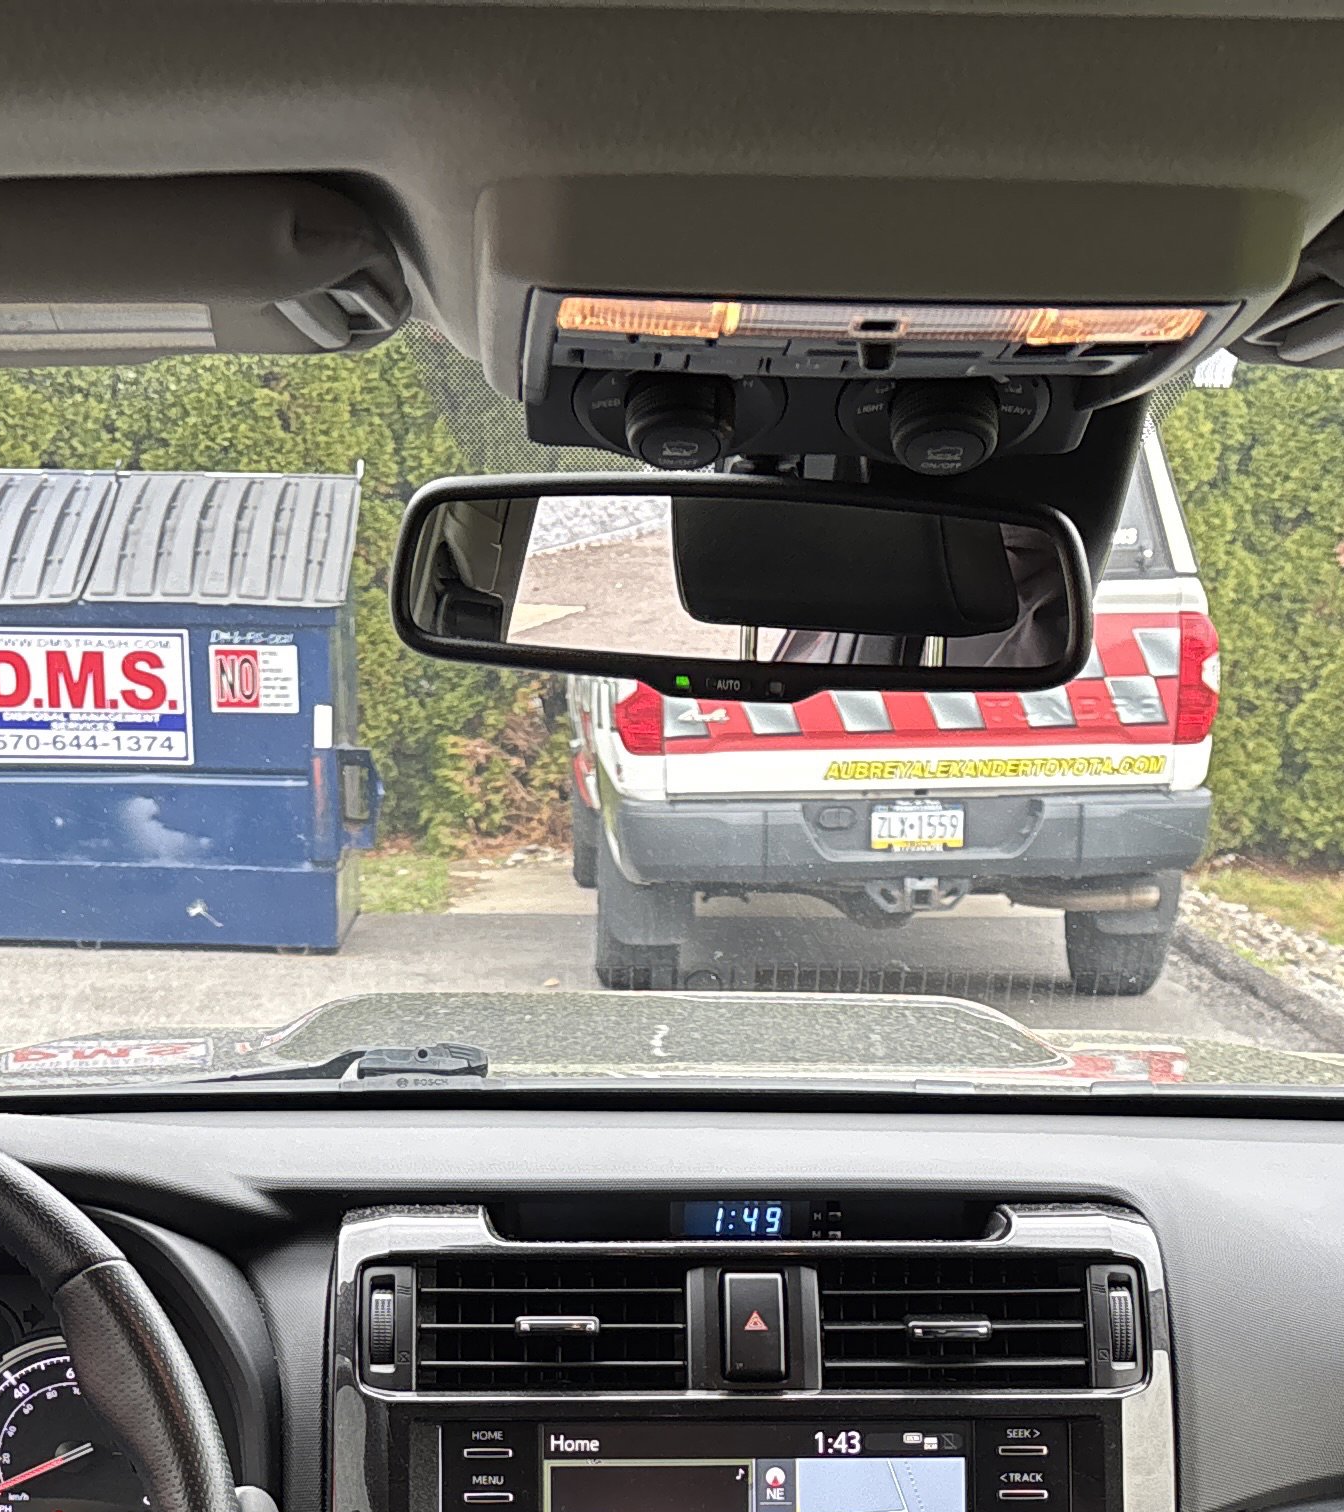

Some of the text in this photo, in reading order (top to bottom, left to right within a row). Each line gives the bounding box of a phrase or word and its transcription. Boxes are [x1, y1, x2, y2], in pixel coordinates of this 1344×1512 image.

[856, 403, 885, 415] LIGHT
[1000, 404, 1032, 416] HEAVY
[215, 654, 259, 703] NO
[716, 679, 741, 691] AUTO
[824, 754, 1167, 781] AUBREYALEXANDERTOYOTA.COM
[413, 1078, 449, 1086] BOSCH
[714, 1207, 783, 1233] 1:49
[65, 1367, 76, 1379] 6
[13, 1382, 30, 1399] 40
[471, 1430, 504, 1441] HOME
[1006, 1428, 1032, 1439] SEEK
[549, 1434, 600, 1452] Home
[814, 1431, 861, 1454] 1:43
[471, 1475, 504, 1485] MENU
[1008, 1473, 1044, 1483] TRACK
[766, 1488, 785, 1500] NE
